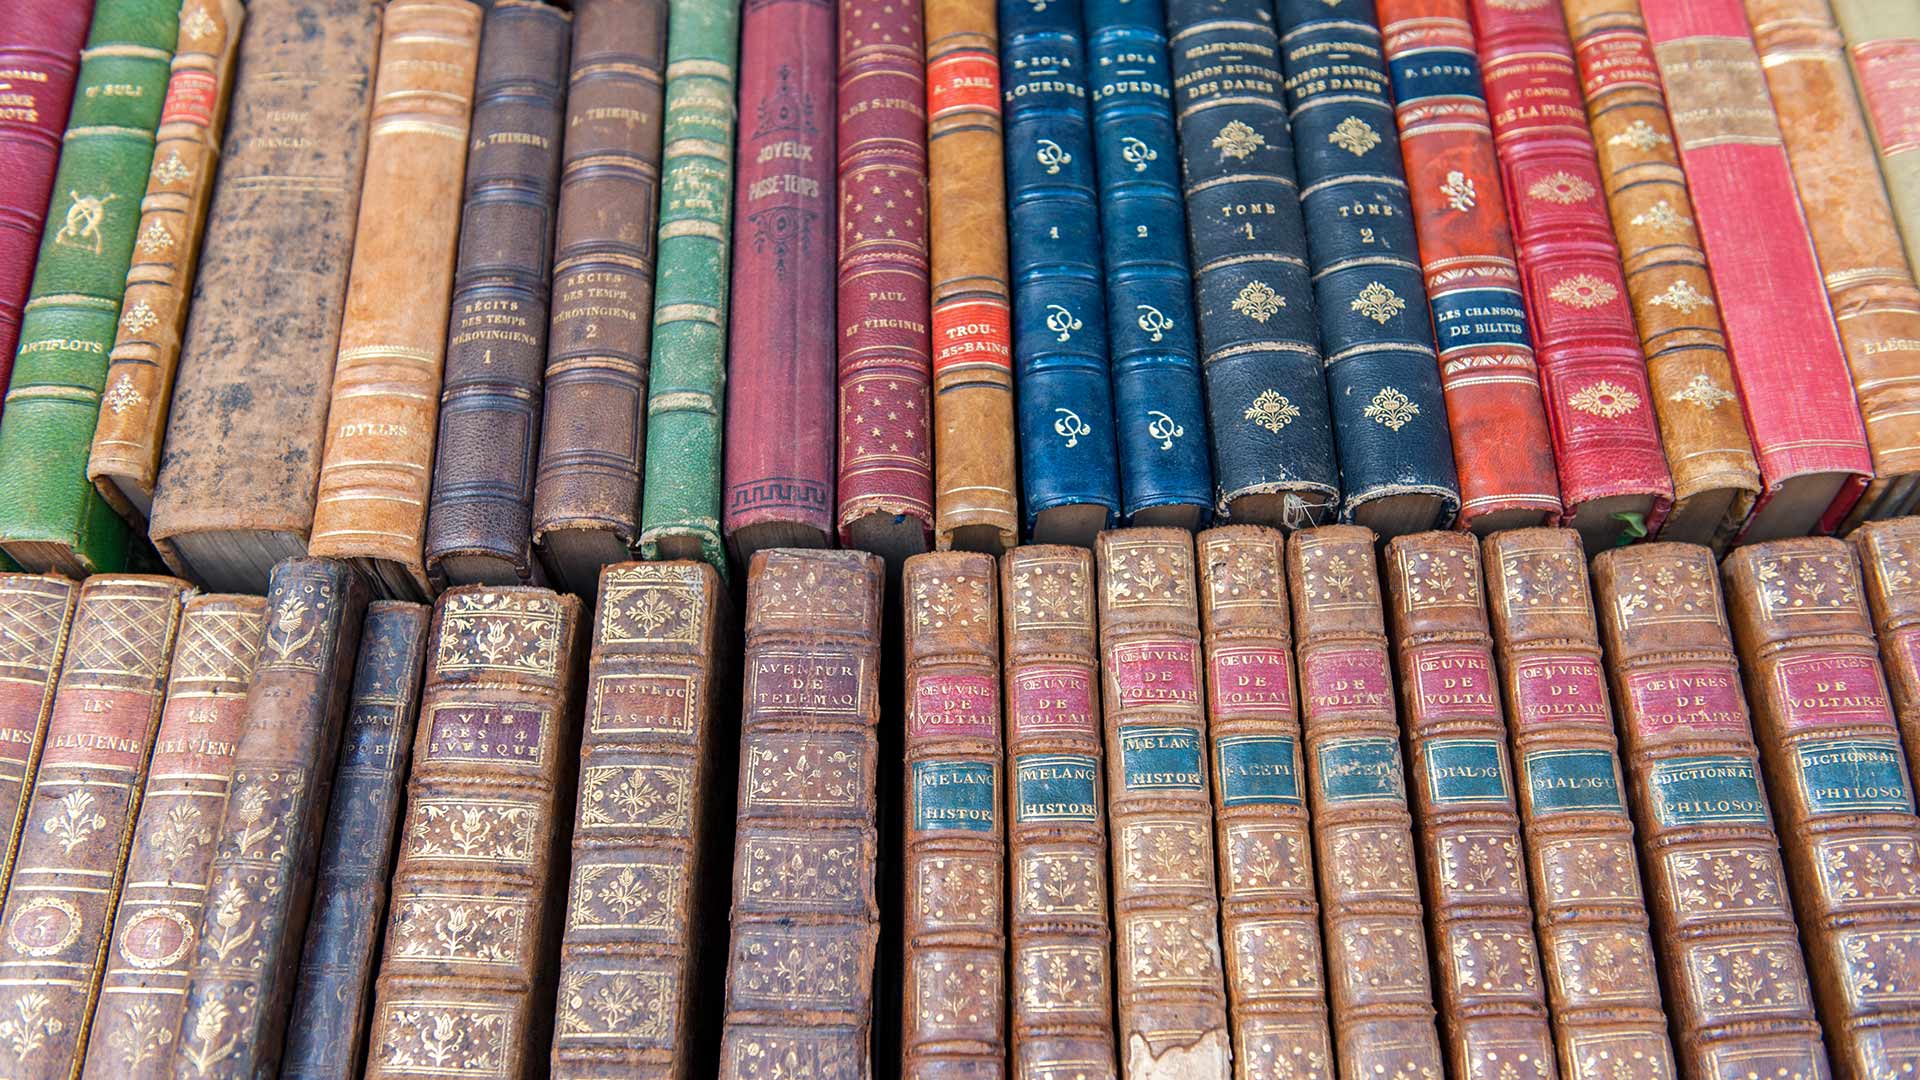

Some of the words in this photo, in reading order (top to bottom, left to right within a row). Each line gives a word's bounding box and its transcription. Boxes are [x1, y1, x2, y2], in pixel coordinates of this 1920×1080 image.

[1031, 56, 1071, 67] ZOLA
[1117, 53, 1156, 64] ZOLA
[1175, 65, 1223, 88] MAISON
[1422, 65, 1472, 77] LOUYS
[1006, 81, 1085, 101] LOURDES
[1093, 81, 1170, 101] LOURDES
[1188, 81, 1219, 99] DES
[1222, 79, 1274, 93] DAMES
[1296, 80, 1327, 98] DES
[1330, 79, 1382, 94] DAMES
[1505, 88, 1521, 102] AU
[586, 107, 649, 124] THIERRY
[1494, 108, 1517, 127] DE
[1518, 105, 1540, 118] LA
[488, 132, 549, 149] THIERRY
[757, 141, 813, 163] JOYEUX
[748, 174, 819, 200] PASSE-TEMPS
[1222, 203, 1275, 216] TOME
[1338, 204, 1393, 217] TOME
[1049, 225, 1060, 239] 1
[1137, 225, 1148, 238] 2
[1245, 222, 1255, 240] 1
[1360, 228, 1374, 244] 2
[567, 272, 622, 286] RÉCITS
[563, 289, 585, 301] DES
[588, 287, 628, 300] TEMPS
[869, 292, 906, 302] PAUL
[465, 299, 519, 314] RÉCITS
[461, 315, 483, 327] DES
[486, 313, 526, 326] TEMPS
[553, 306, 638, 322] MÉROVINGIENS
[1438, 309, 1462, 323] LES
[1465, 307, 1526, 320] CHANSONS
[586, 324, 597, 338] 2
[846, 324, 860, 336] ET
[864, 318, 925, 334] VIRGINIE
[946, 323, 997, 339] TROU-
[1450, 325, 1471, 337] DE
[1475, 323, 1523, 335] BILITIS
[451, 329, 537, 346] MÉROVINGIENS
[483, 350, 491, 363] 1
[339, 422, 408, 438] IDYLLES
[1144, 672, 1174, 682] DE
[1238, 676, 1267, 687] DE
[1444, 677, 1473, 689] DE
[793, 679, 824, 690] DE
[1336, 679, 1366, 691] DE
[1551, 684, 1580, 696] DE
[1816, 681, 1847, 693] DE
[84, 699, 114, 713] LES
[944, 699, 972, 710] DE
[1039, 699, 1068, 709] DE
[1677, 696, 1707, 707] DE
[1789, 696, 1885, 708] VOLTAIRE
[188, 708, 219, 723] LES
[1649, 711, 1743, 725] VOLTAIRE
[441, 728, 487, 740] DES
[514, 731, 528, 743] 4
[1801, 752, 1896, 768] DICTIONNAI
[1023, 769, 1097, 782] MELANG
[1666, 800, 1764, 814] PHILOSOP
[35, 916, 50, 937] 3
[146, 927, 162, 950] 4
